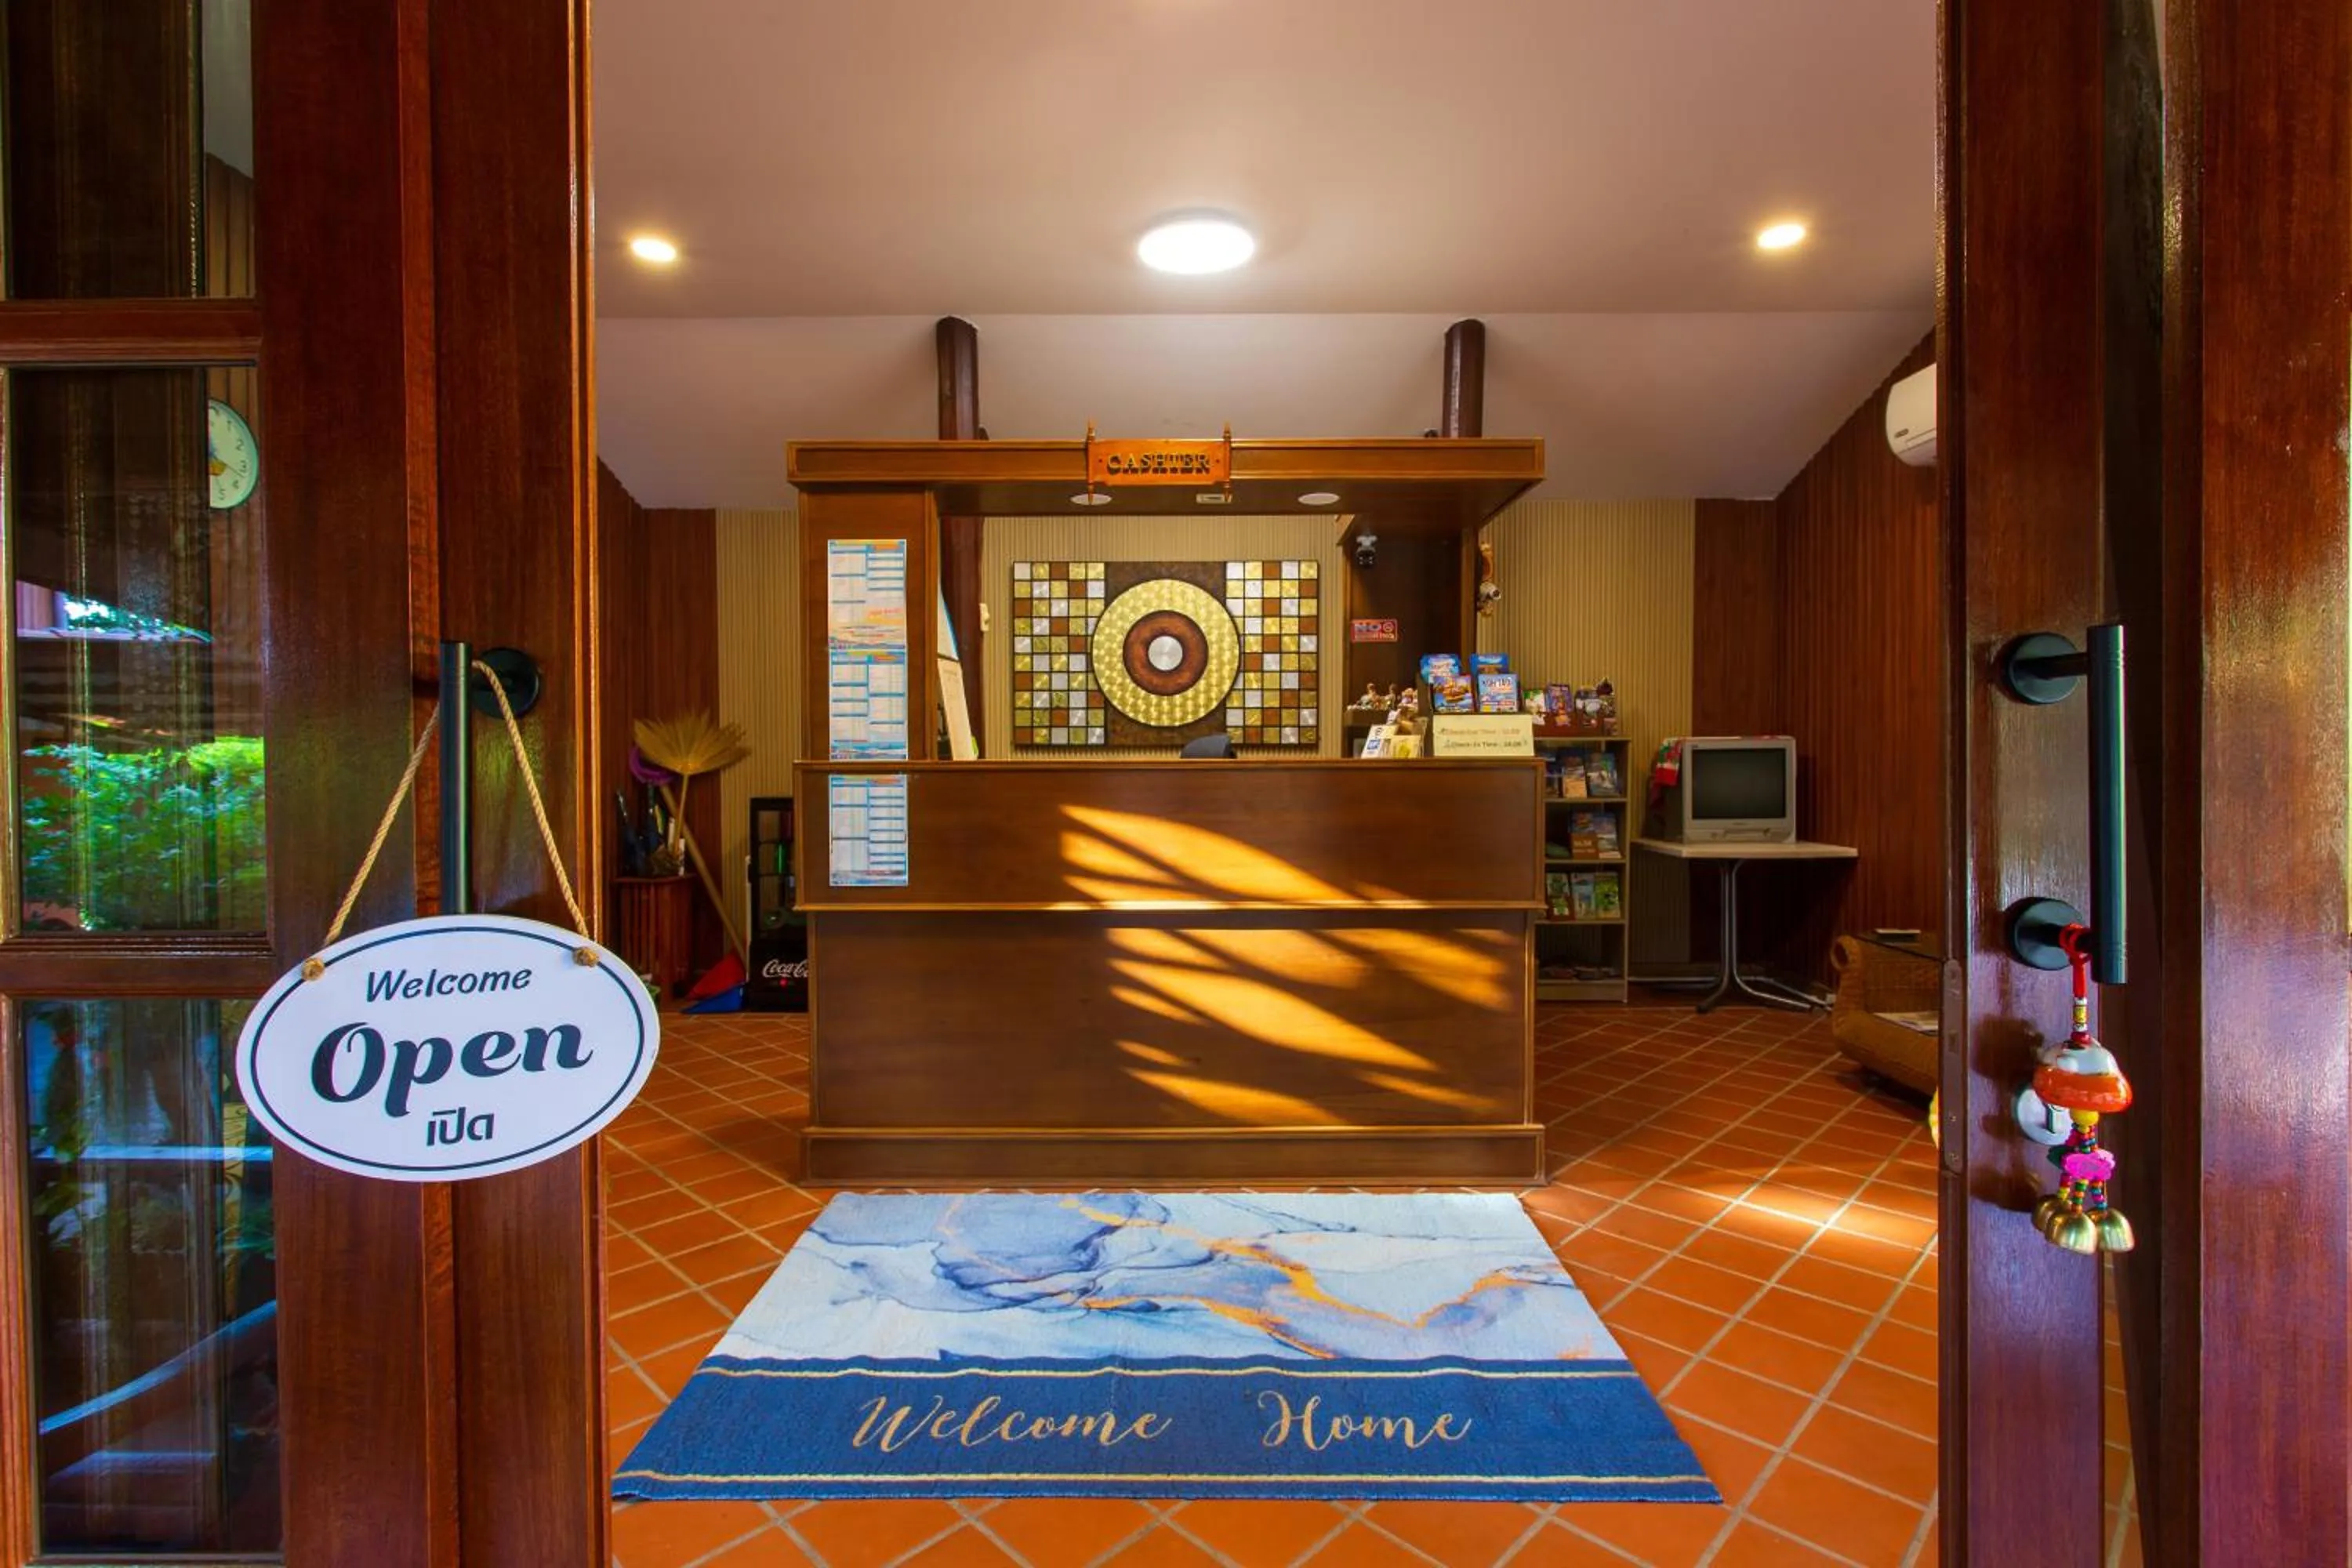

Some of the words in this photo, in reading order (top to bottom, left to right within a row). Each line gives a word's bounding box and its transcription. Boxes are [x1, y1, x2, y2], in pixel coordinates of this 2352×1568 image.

[236, 438, 245, 452] 2
[1106, 453, 1210, 475] CASHIER
[366, 967, 532, 1003] Welcome
[310, 1022, 593, 1117] Open
[426, 1106, 495, 1146] เปิด
[851, 1395, 1173, 1453] Welcome
[1258, 1390, 1472, 1452] Home
